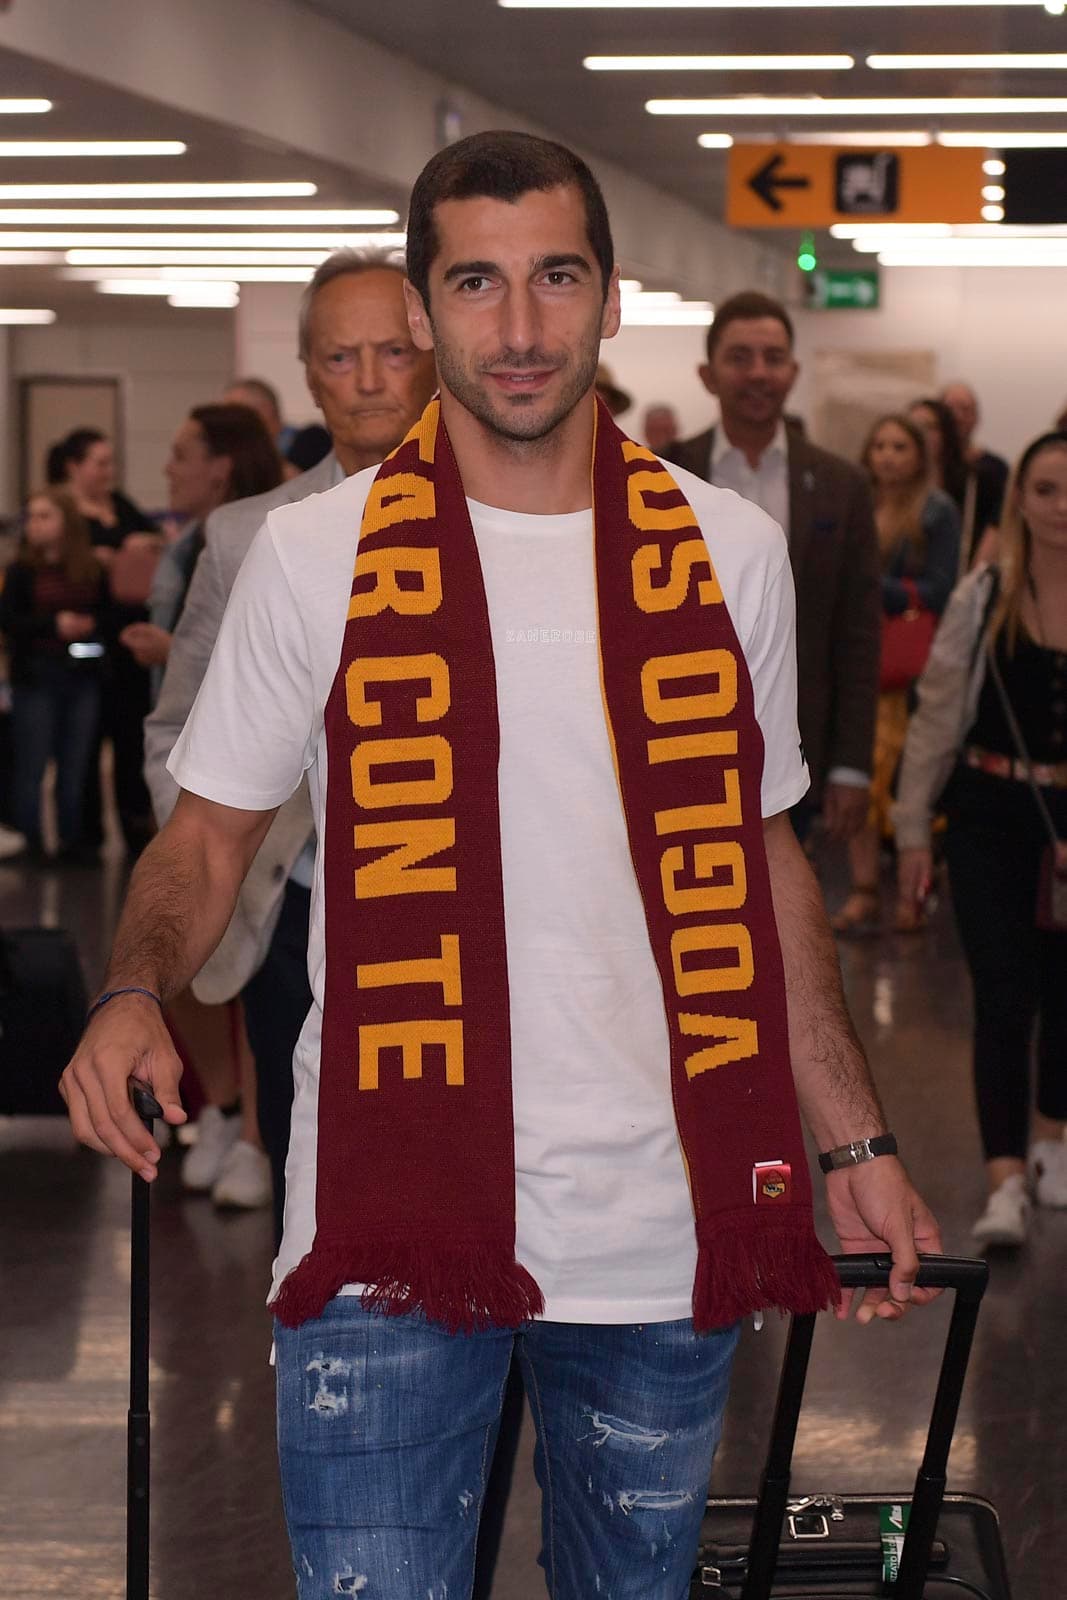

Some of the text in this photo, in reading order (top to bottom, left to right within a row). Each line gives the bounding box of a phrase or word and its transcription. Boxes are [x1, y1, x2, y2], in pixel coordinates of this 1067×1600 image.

[345, 653, 457, 899] CON
[640, 648, 759, 1081] VOGLIO
[356, 934, 465, 1091] TE
